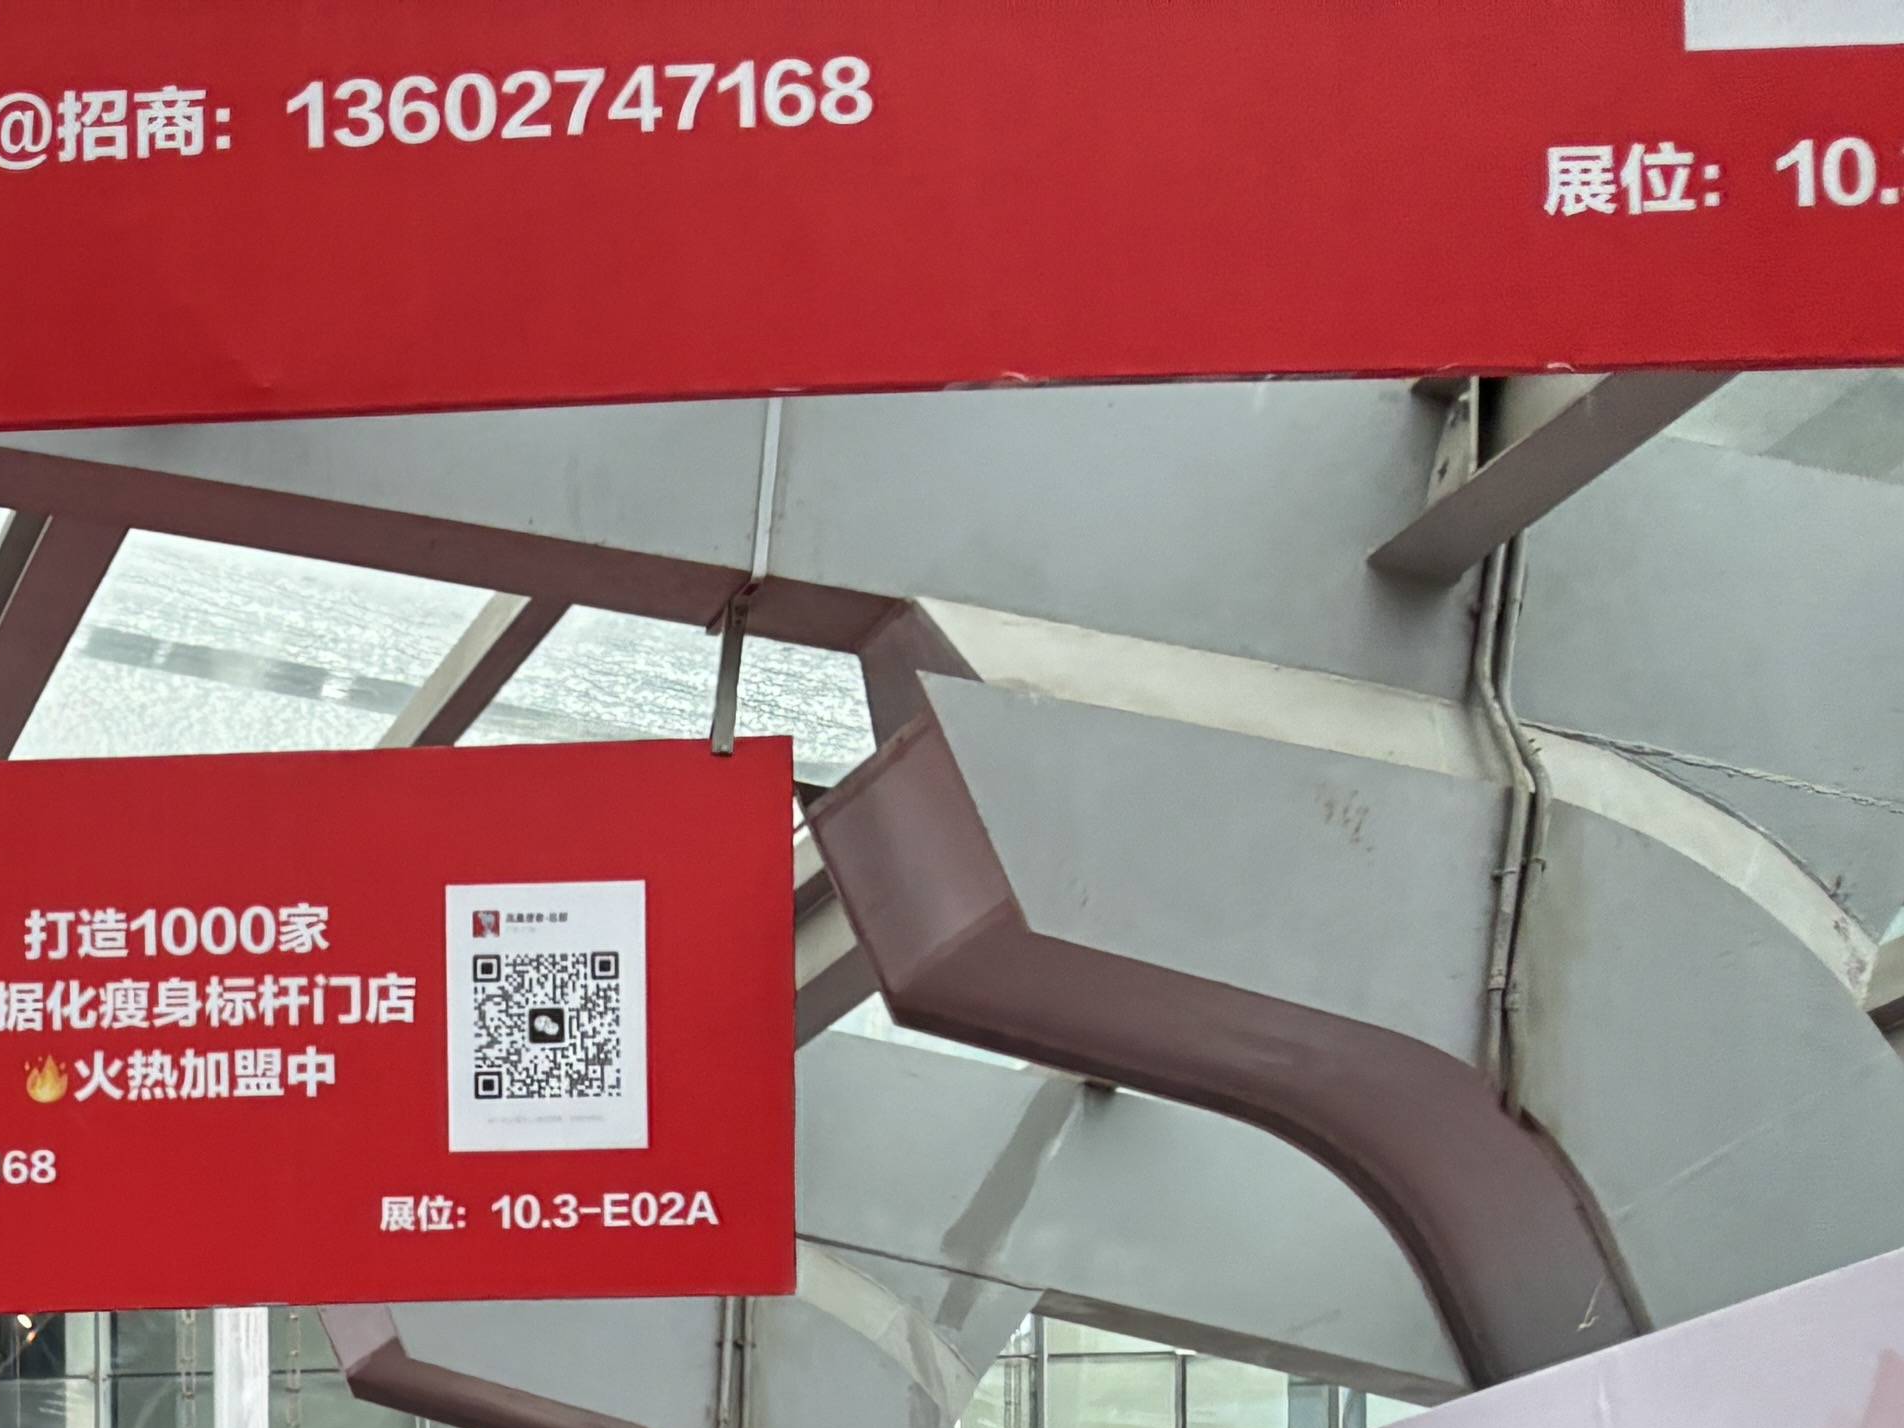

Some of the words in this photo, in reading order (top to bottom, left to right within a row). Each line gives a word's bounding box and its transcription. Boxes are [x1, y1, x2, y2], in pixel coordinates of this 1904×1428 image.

[287, 56, 874, 149] 13602747168
[24, 902, 330, 960] 打造1000家
[74, 1045, 337, 1101] 火热加盟中
[492, 1190, 719, 1230] 10.3-E02A
